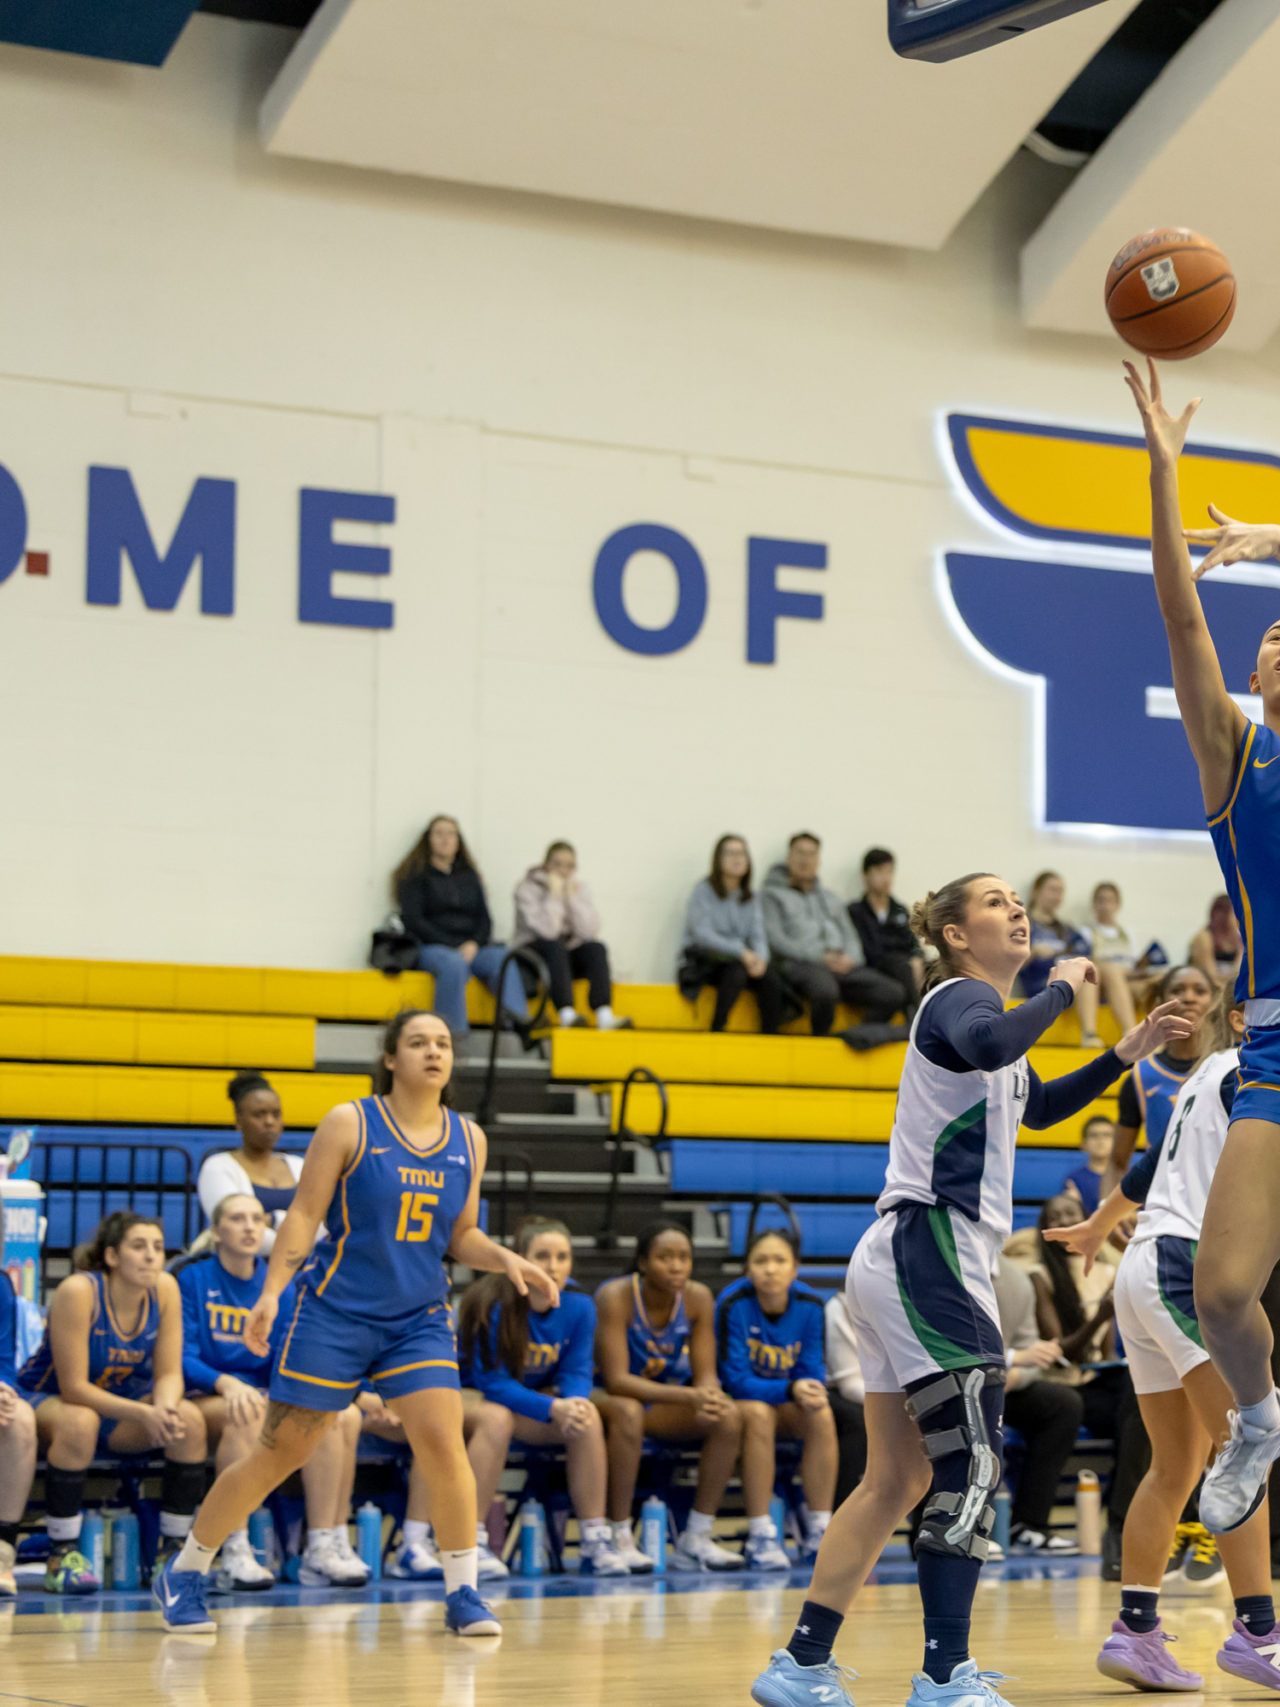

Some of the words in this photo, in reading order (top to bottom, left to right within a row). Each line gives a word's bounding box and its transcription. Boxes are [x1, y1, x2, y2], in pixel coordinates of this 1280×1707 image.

[592, 521, 829, 666] OF
[397, 1166, 445, 1188] TMU
[395, 1191, 439, 1242] 15
[206, 1301, 251, 1332] TM
